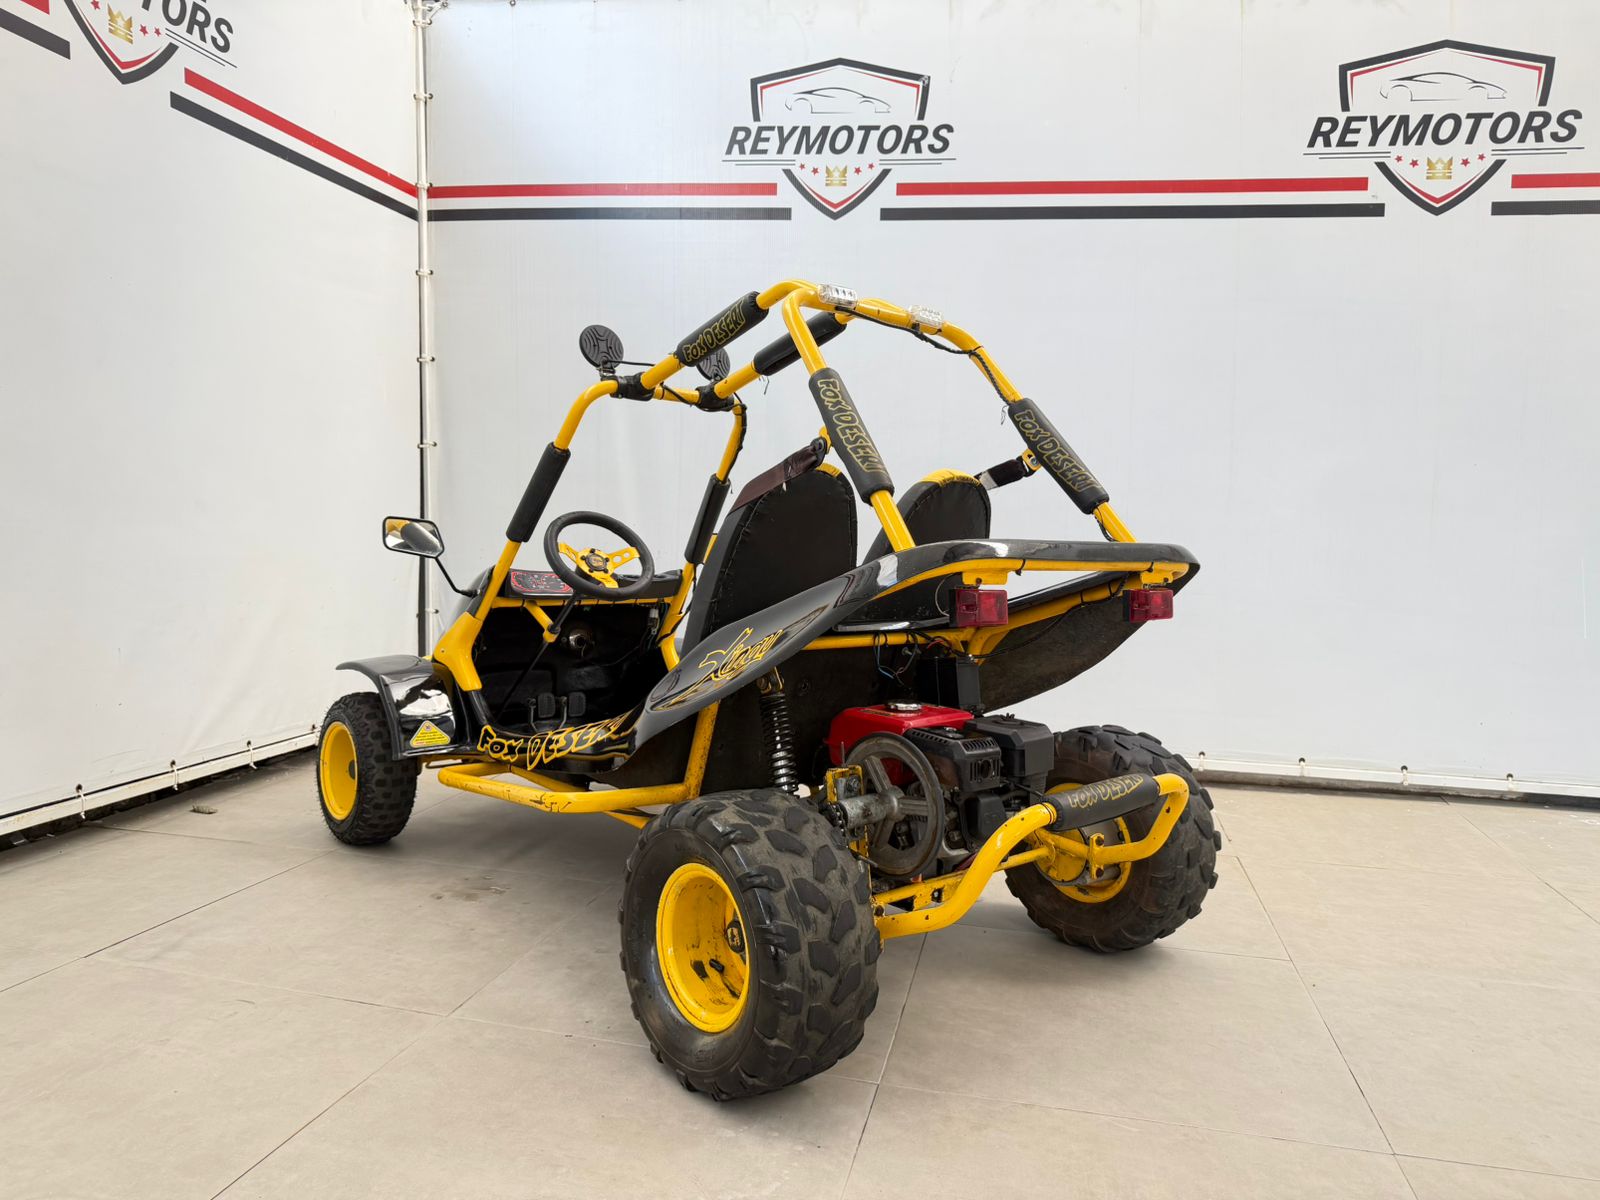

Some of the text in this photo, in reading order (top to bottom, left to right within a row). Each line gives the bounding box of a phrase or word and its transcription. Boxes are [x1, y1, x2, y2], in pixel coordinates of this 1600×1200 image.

[725, 124, 954, 155] REYMOTORS
[1306, 109, 1583, 148] REYMOTORS
[682, 334, 707, 362] FOX
[817, 378, 851, 411] FOX
[1014, 410, 1050, 441] FOX
[1067, 786, 1099, 808] FOX
